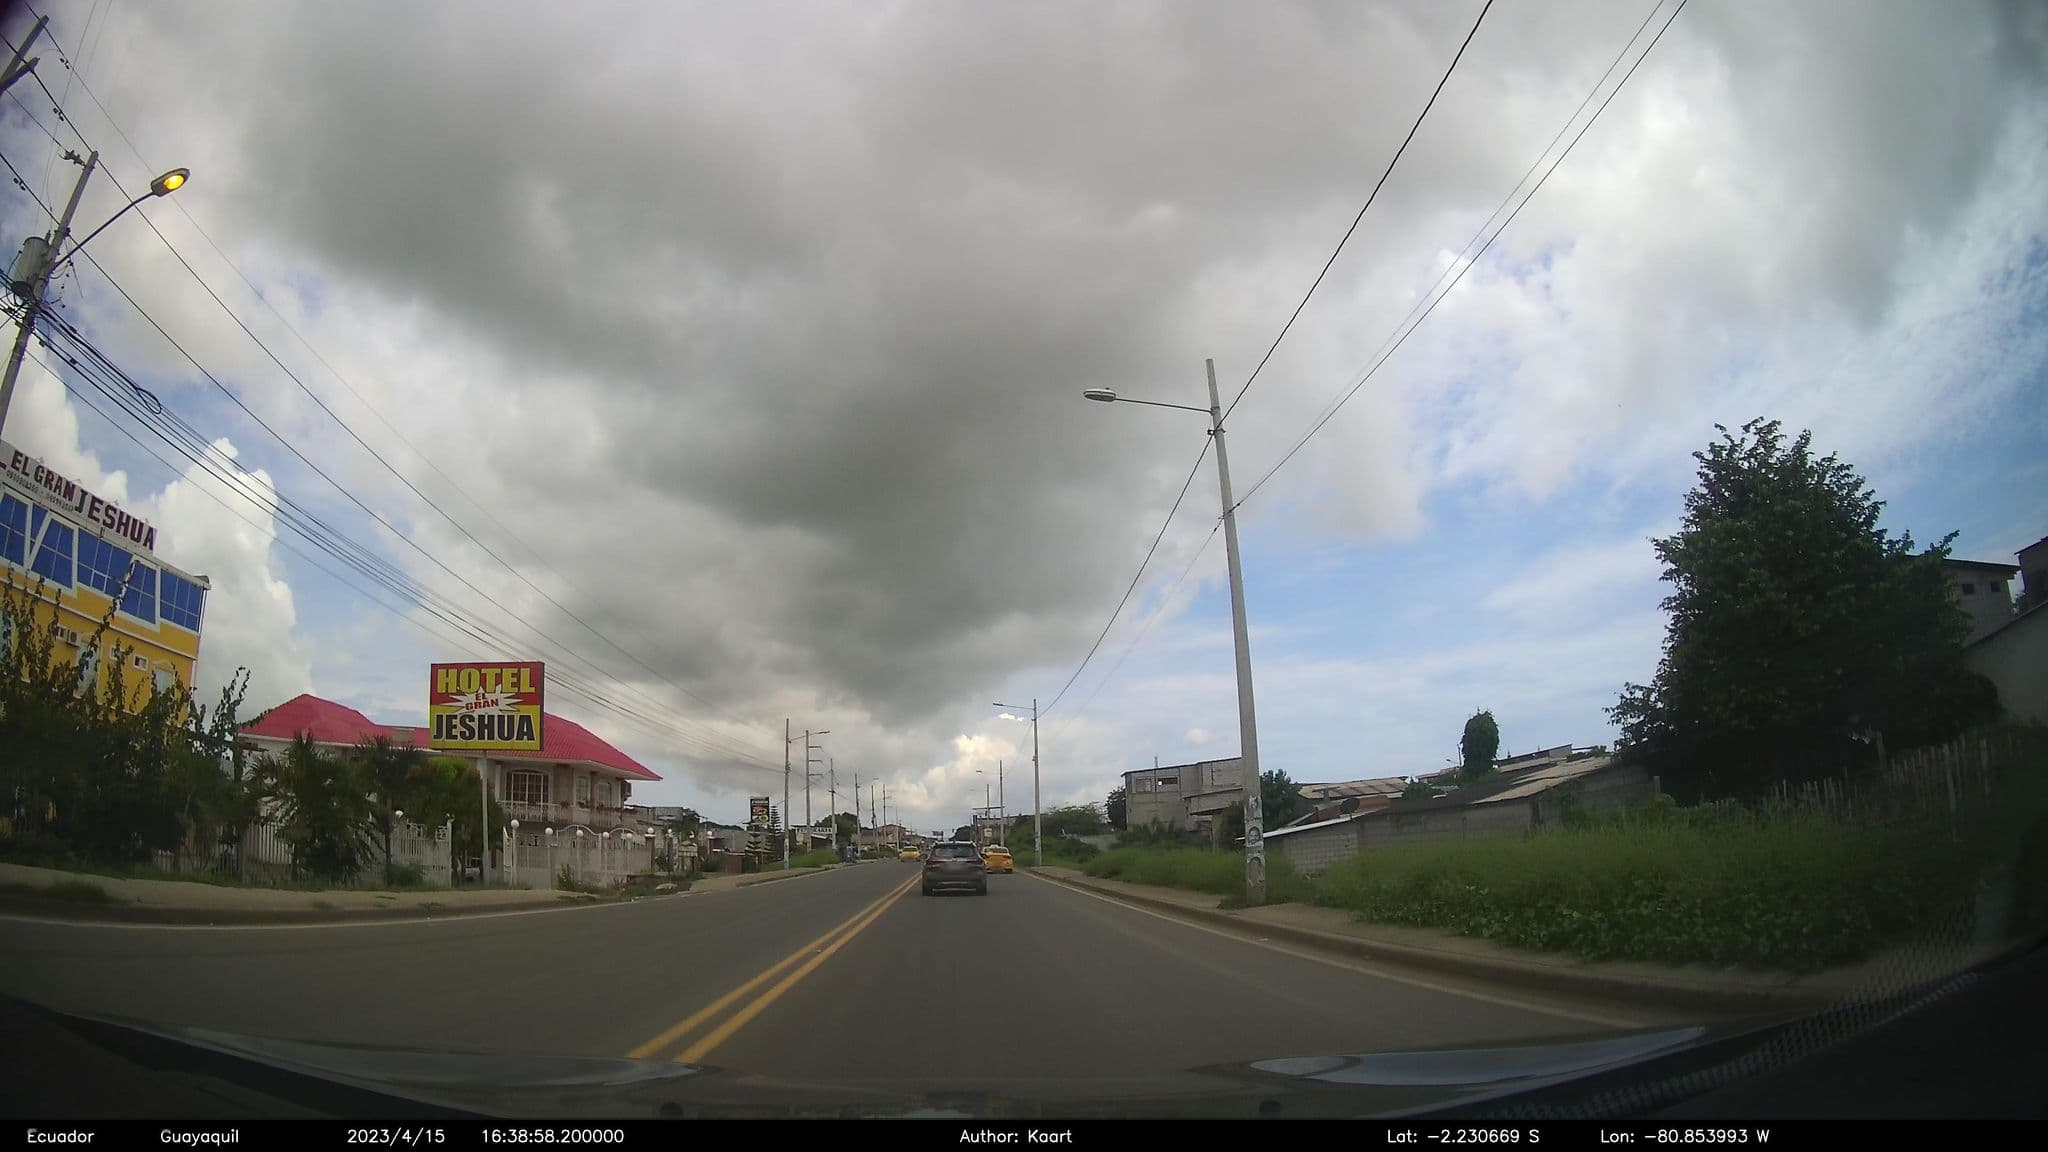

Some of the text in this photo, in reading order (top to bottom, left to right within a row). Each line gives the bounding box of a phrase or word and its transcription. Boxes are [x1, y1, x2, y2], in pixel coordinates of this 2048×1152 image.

[11, 450, 31, 477] EL
[34, 466, 76, 501] GRAN
[75, 488, 156, 550] JESHUA
[437, 668, 535, 693] HOTEL
[465, 699, 499, 711] GRAN
[475, 692, 487, 700] EL
[434, 714, 535, 741] JESHUA
